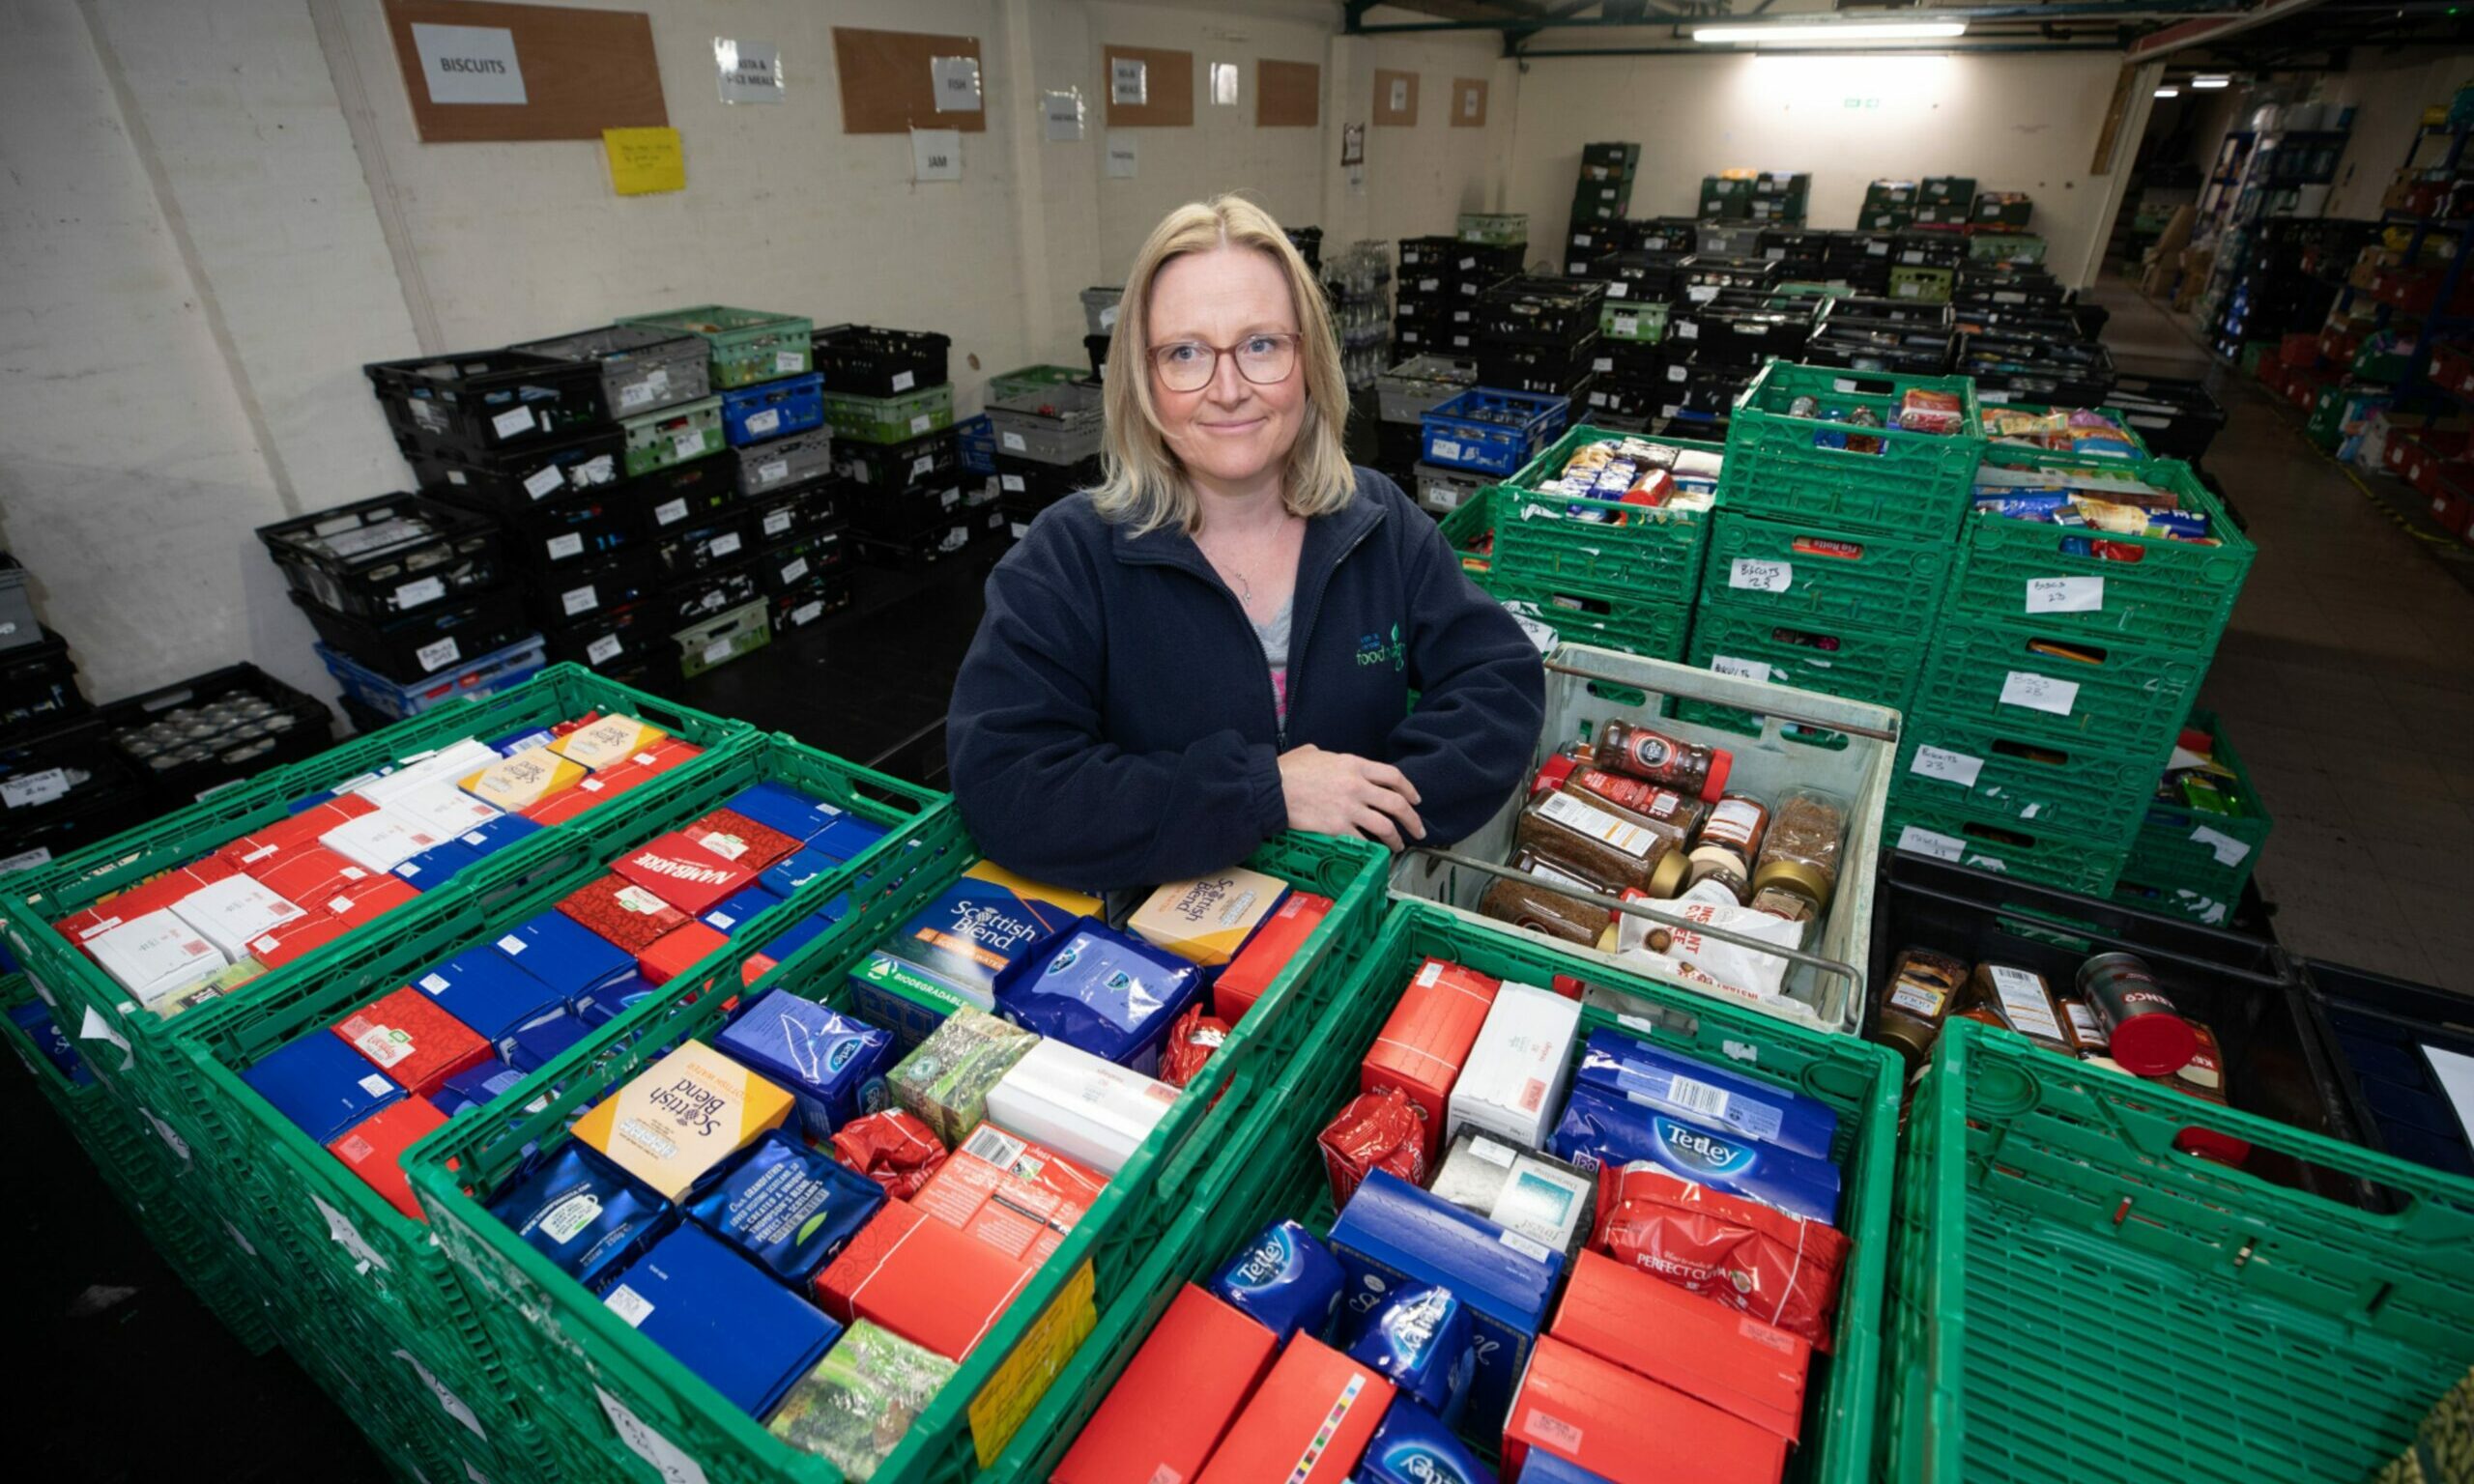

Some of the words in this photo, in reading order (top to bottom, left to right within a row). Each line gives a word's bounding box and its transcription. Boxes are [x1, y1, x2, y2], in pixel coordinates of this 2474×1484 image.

[441, 57, 505, 74] BISCUITS
[928, 156, 948, 167] JAM
[1356, 646, 1385, 666] food
[631, 851, 736, 885] NAMBARRIE
[951, 900, 1036, 942] Scottish
[951, 917, 1012, 951] Blend
[649, 1087, 721, 1136] Scottish
[671, 1078, 725, 1115] Blend
[1667, 1124, 1740, 1166] Tetley
[743, 1162, 785, 1198] GRANDFATHER
[746, 1197, 777, 1224] CREATED
[755, 1218, 784, 1242] PERFECT
[1237, 1235, 1285, 1283] Tetley
[1636, 1253, 1689, 1277] PERFECT
